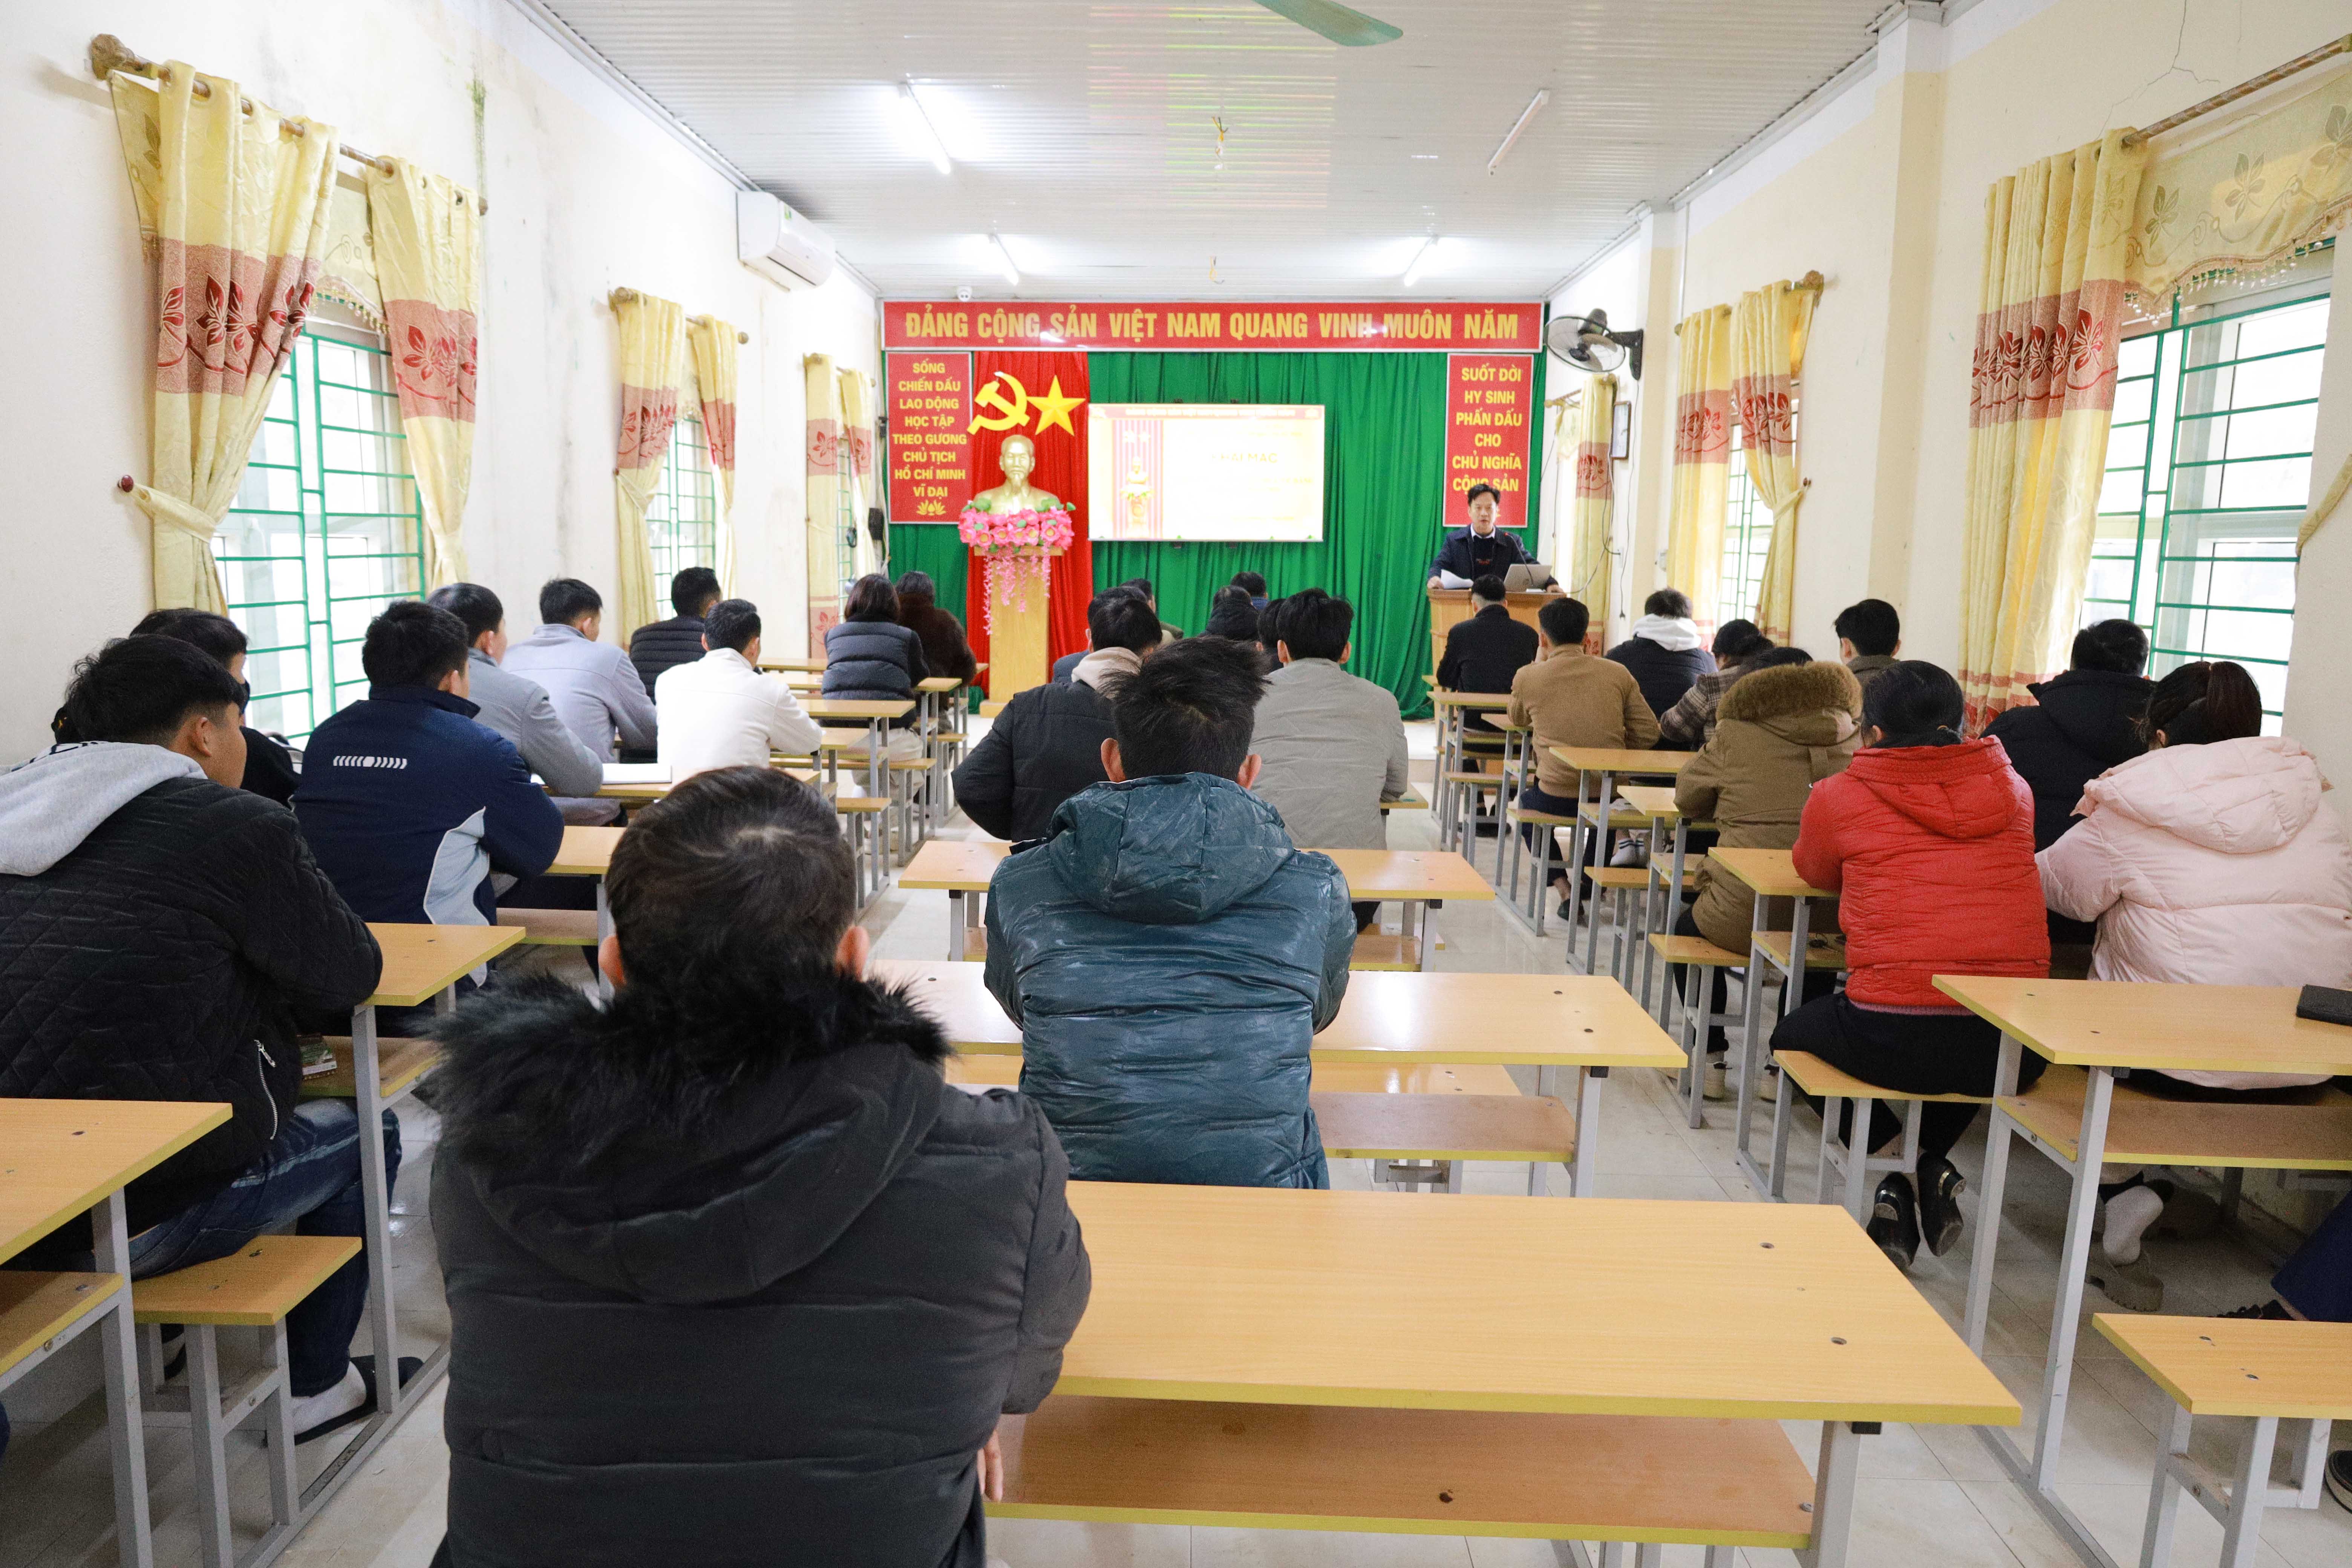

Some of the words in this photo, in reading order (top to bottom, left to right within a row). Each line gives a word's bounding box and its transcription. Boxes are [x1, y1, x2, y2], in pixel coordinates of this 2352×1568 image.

[906, 304, 969, 338] ĐẢNG
[977, 308, 1041, 343] CỘNG
[1050, 305, 1097, 338] SẢN
[1110, 309, 1158, 343] VIỆT
[1167, 313, 1221, 338] NAM
[1230, 313, 1308, 341] QUANG
[1320, 313, 1373, 338] VINH
[1383, 309, 1452, 340] MUÔN
[1464, 309, 1518, 340] NĂM
[913, 358, 945, 374] SỐNG
[1461, 363, 1496, 382] SUỐT
[1499, 364, 1522, 382] ĐỜI
[899, 377, 933, 391] CHIẾN
[936, 377, 961, 392] ĐẤU
[899, 398, 923, 409] LAO
[1464, 390, 1482, 404] HY
[1485, 390, 1515, 404] SINH
[905, 416, 929, 430] HỌC
[932, 414, 955, 429] TẬP
[1456, 408, 1491, 426] PHẤN
[1494, 408, 1522, 426] ĐẤU
[893, 434, 923, 445] THEO
[1475, 433, 1502, 447] CHO
[903, 447, 927, 462] CHỦ
[930, 451, 956, 465] TỊCH
[1452, 450, 1479, 469] CHỦ
[1482, 453, 1522, 470] NGHĨA
[894, 464, 911, 480] HỒ
[914, 467, 934, 480] CHÍ
[936, 469, 966, 480] MINH
[913, 484, 926, 497] VĨ
[1493, 473, 1519, 492] SẢN
